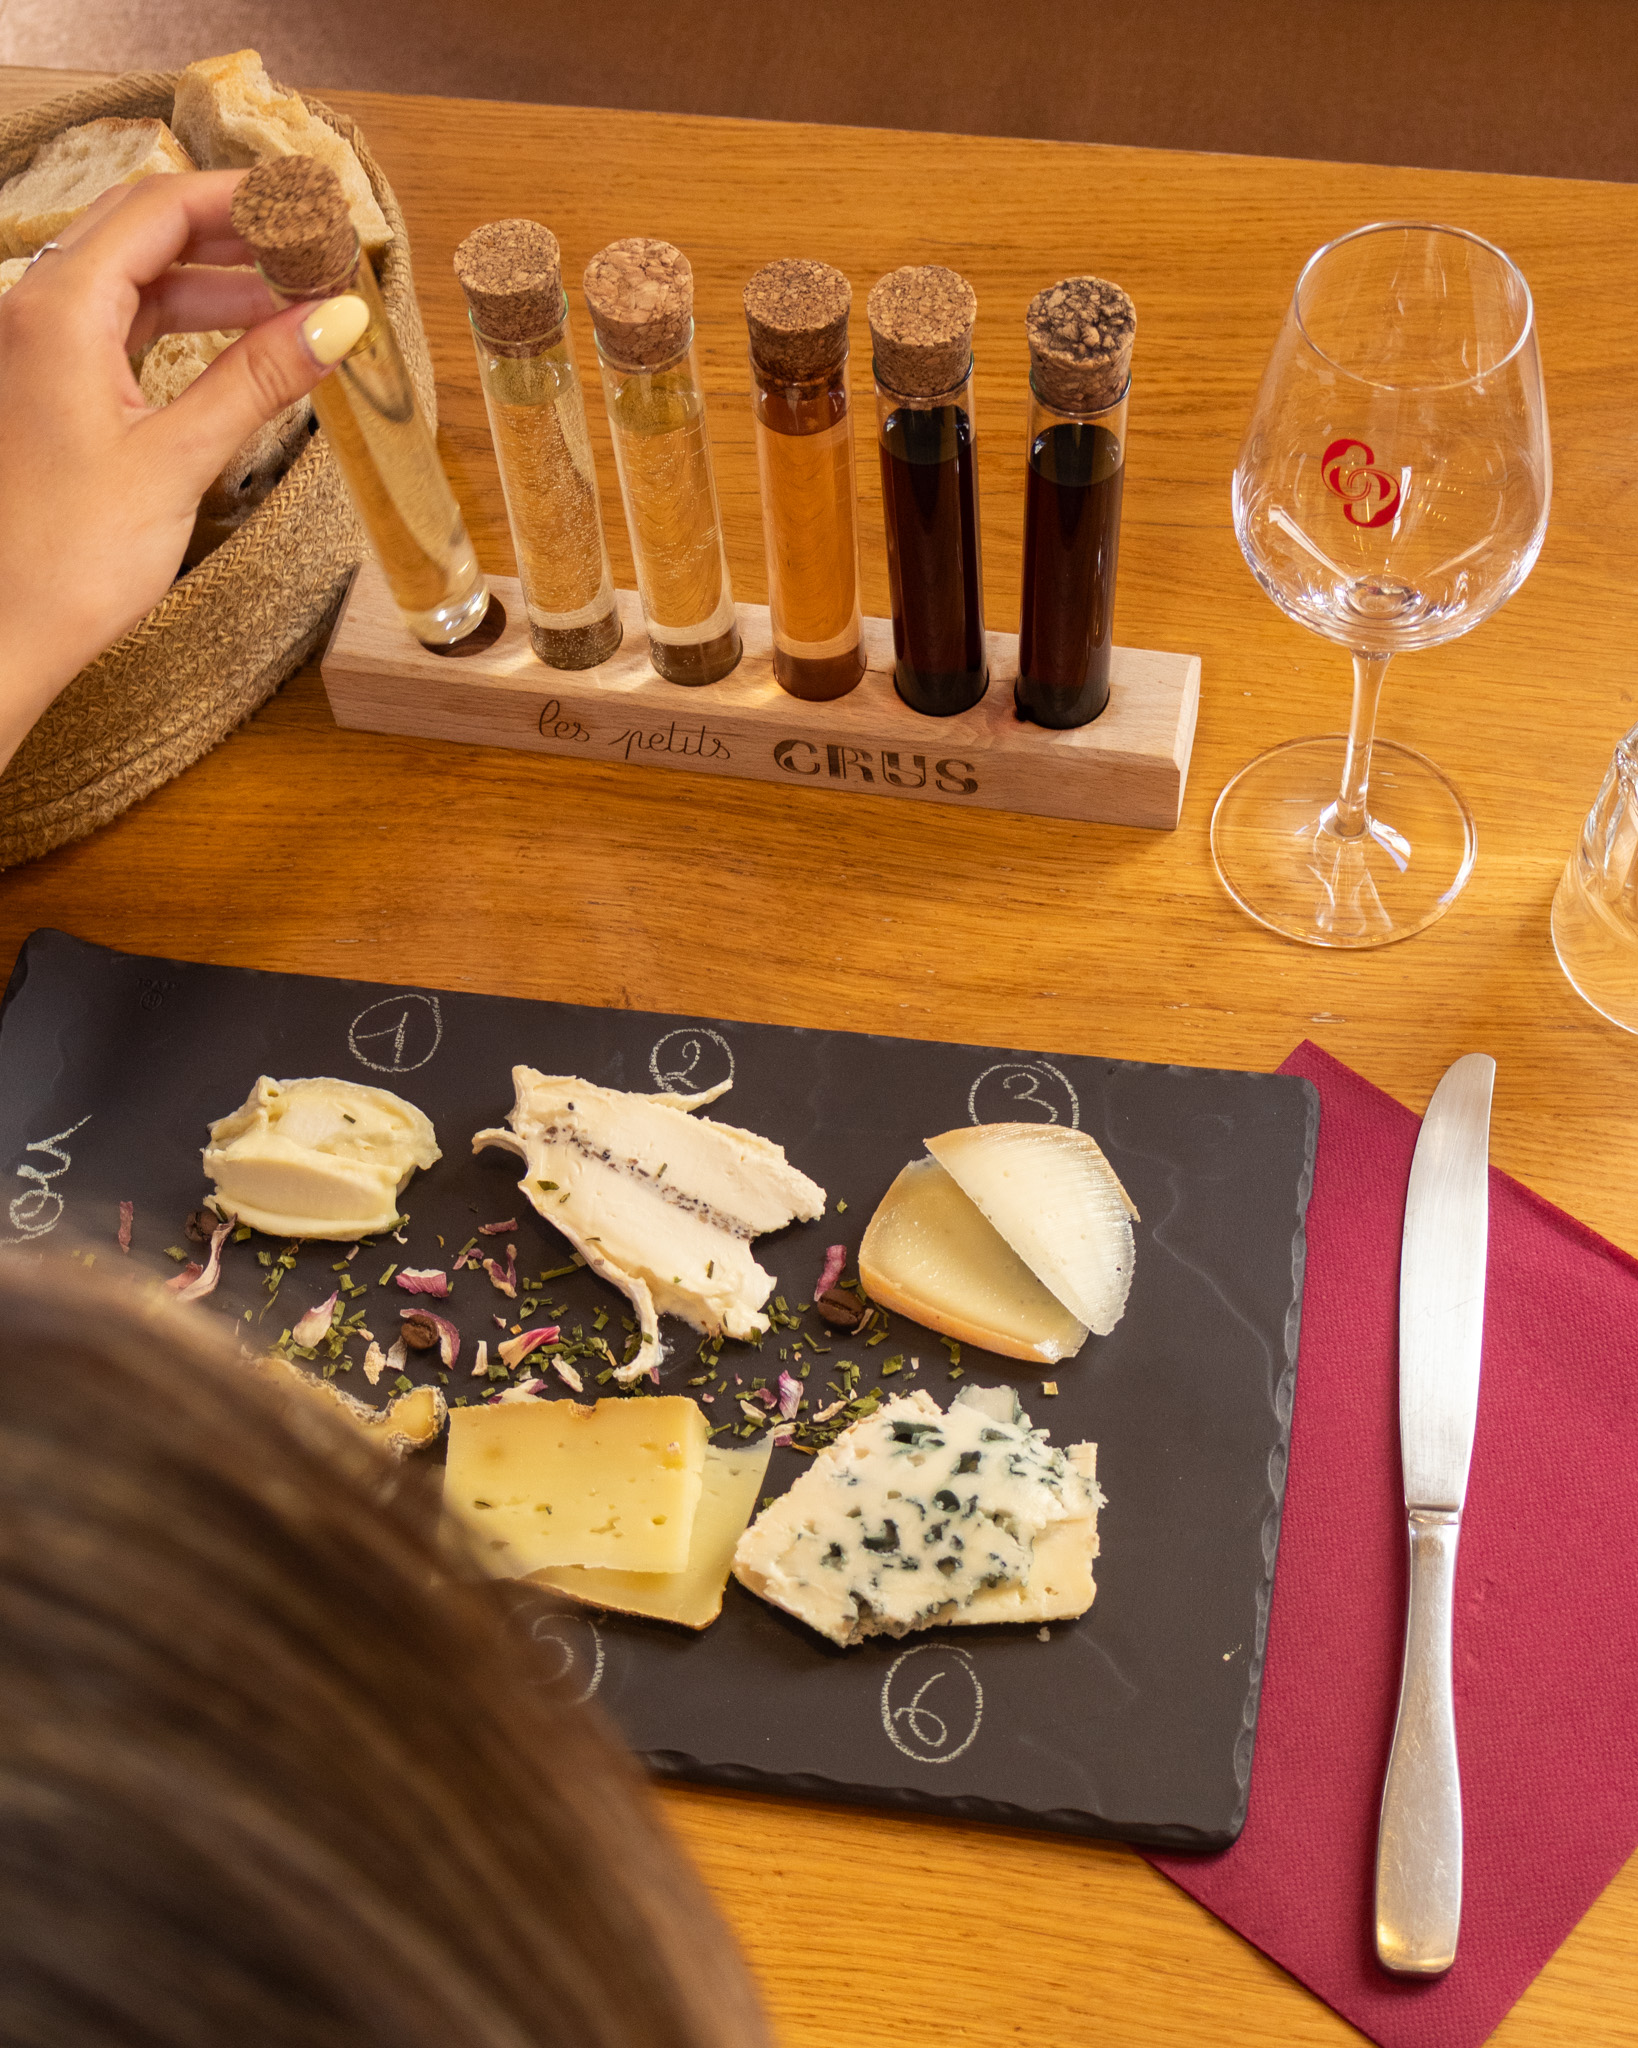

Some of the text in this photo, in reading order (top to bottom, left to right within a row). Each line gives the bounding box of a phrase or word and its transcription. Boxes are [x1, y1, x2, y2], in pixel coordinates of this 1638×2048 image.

[538, 699, 979, 796] les petits CRUS
